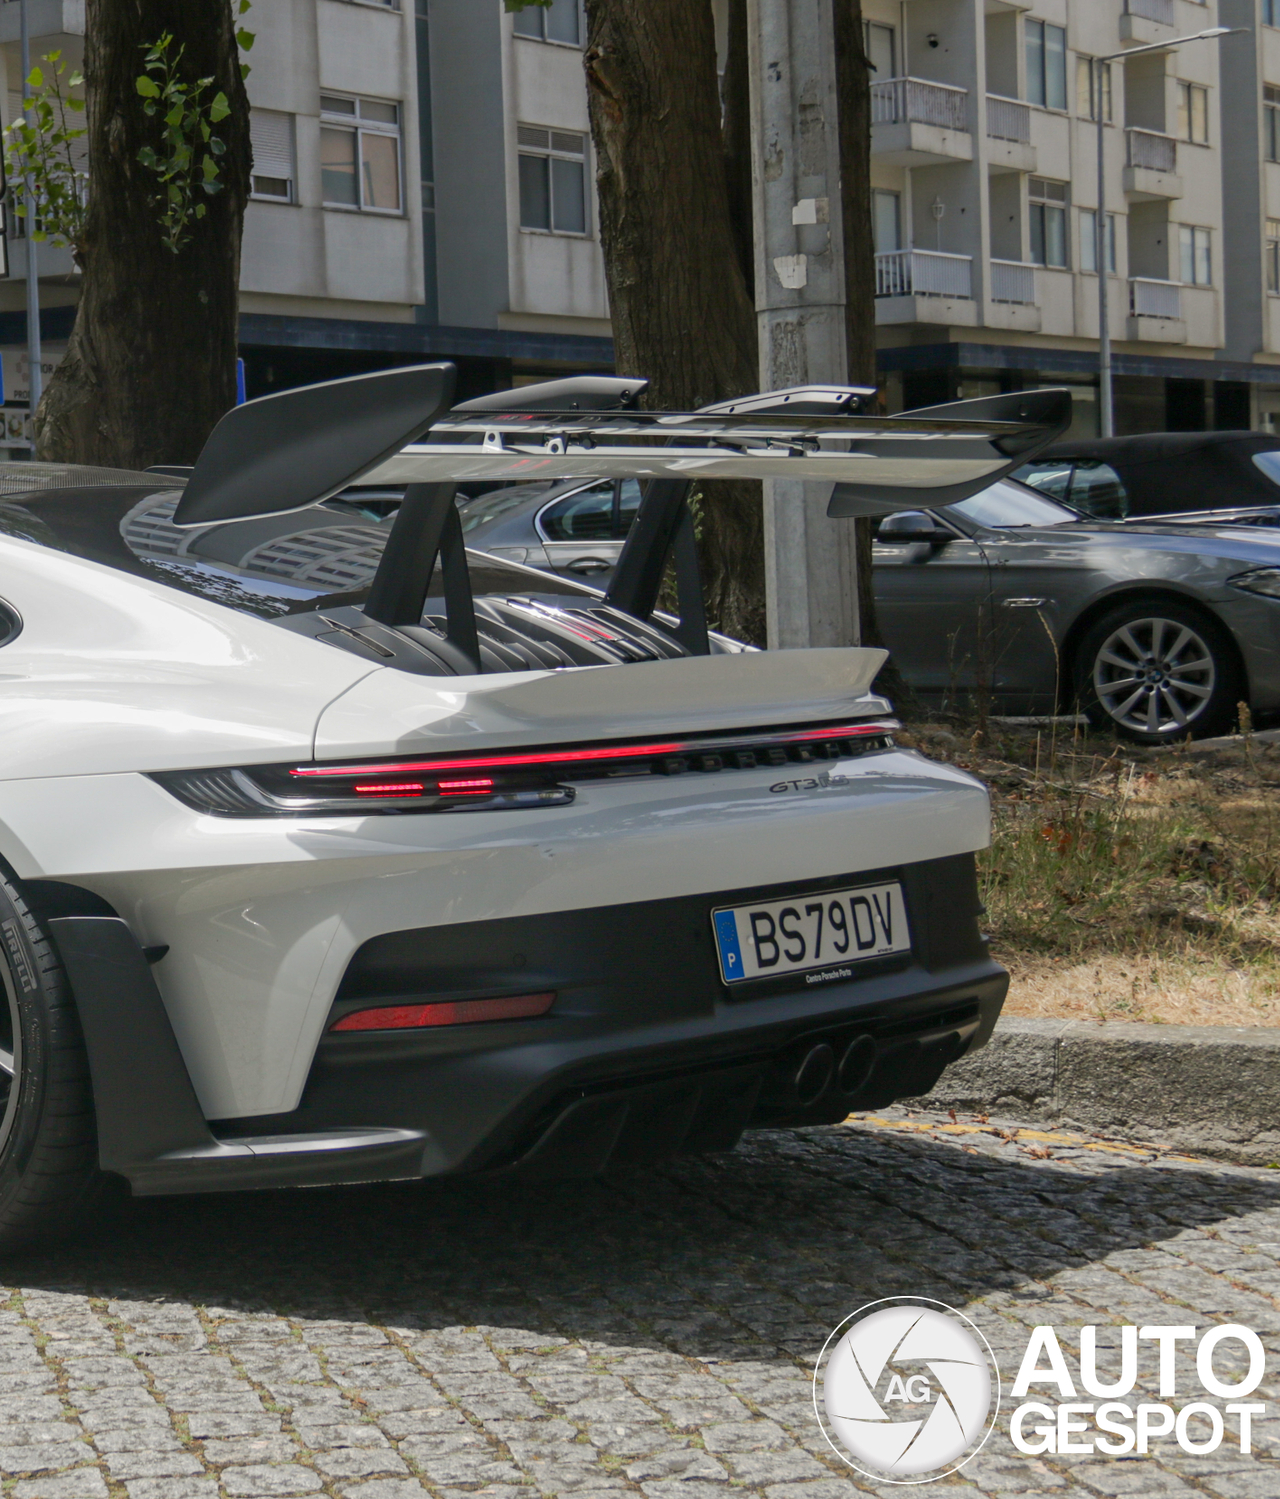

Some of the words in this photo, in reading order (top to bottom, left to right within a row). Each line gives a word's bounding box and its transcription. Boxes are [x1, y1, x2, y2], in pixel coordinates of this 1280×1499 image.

[1, 917, 38, 994] PIRELLI
[728, 953, 736, 967] P
[749, 891, 893, 968] BS79DV
